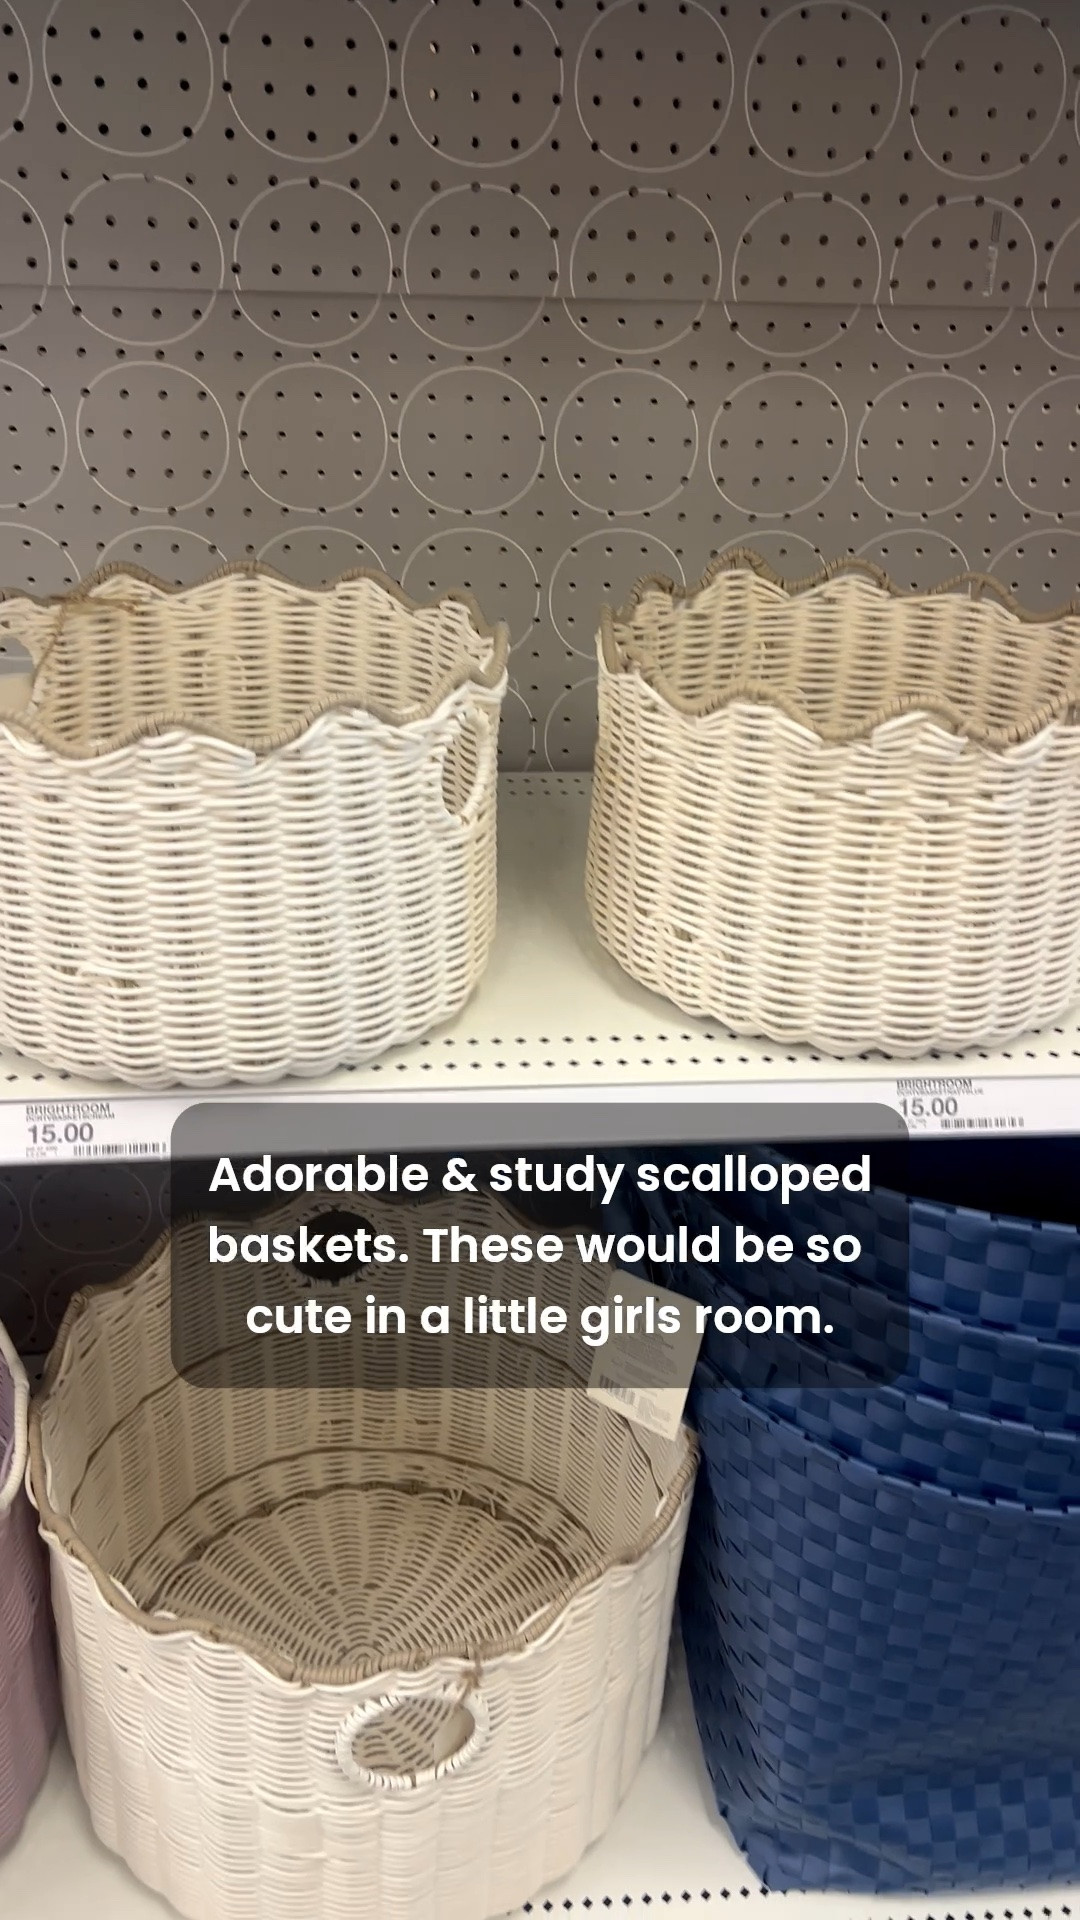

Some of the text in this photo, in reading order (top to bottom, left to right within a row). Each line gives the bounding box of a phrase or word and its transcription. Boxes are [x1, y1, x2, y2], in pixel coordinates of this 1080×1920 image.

[897, 1079, 973, 1089] BRIGHTROOM
[26, 1103, 110, 1115] BRIGHTROOM
[900, 1097, 958, 1117] 15.00
[28, 1122, 94, 1144] 15.00
